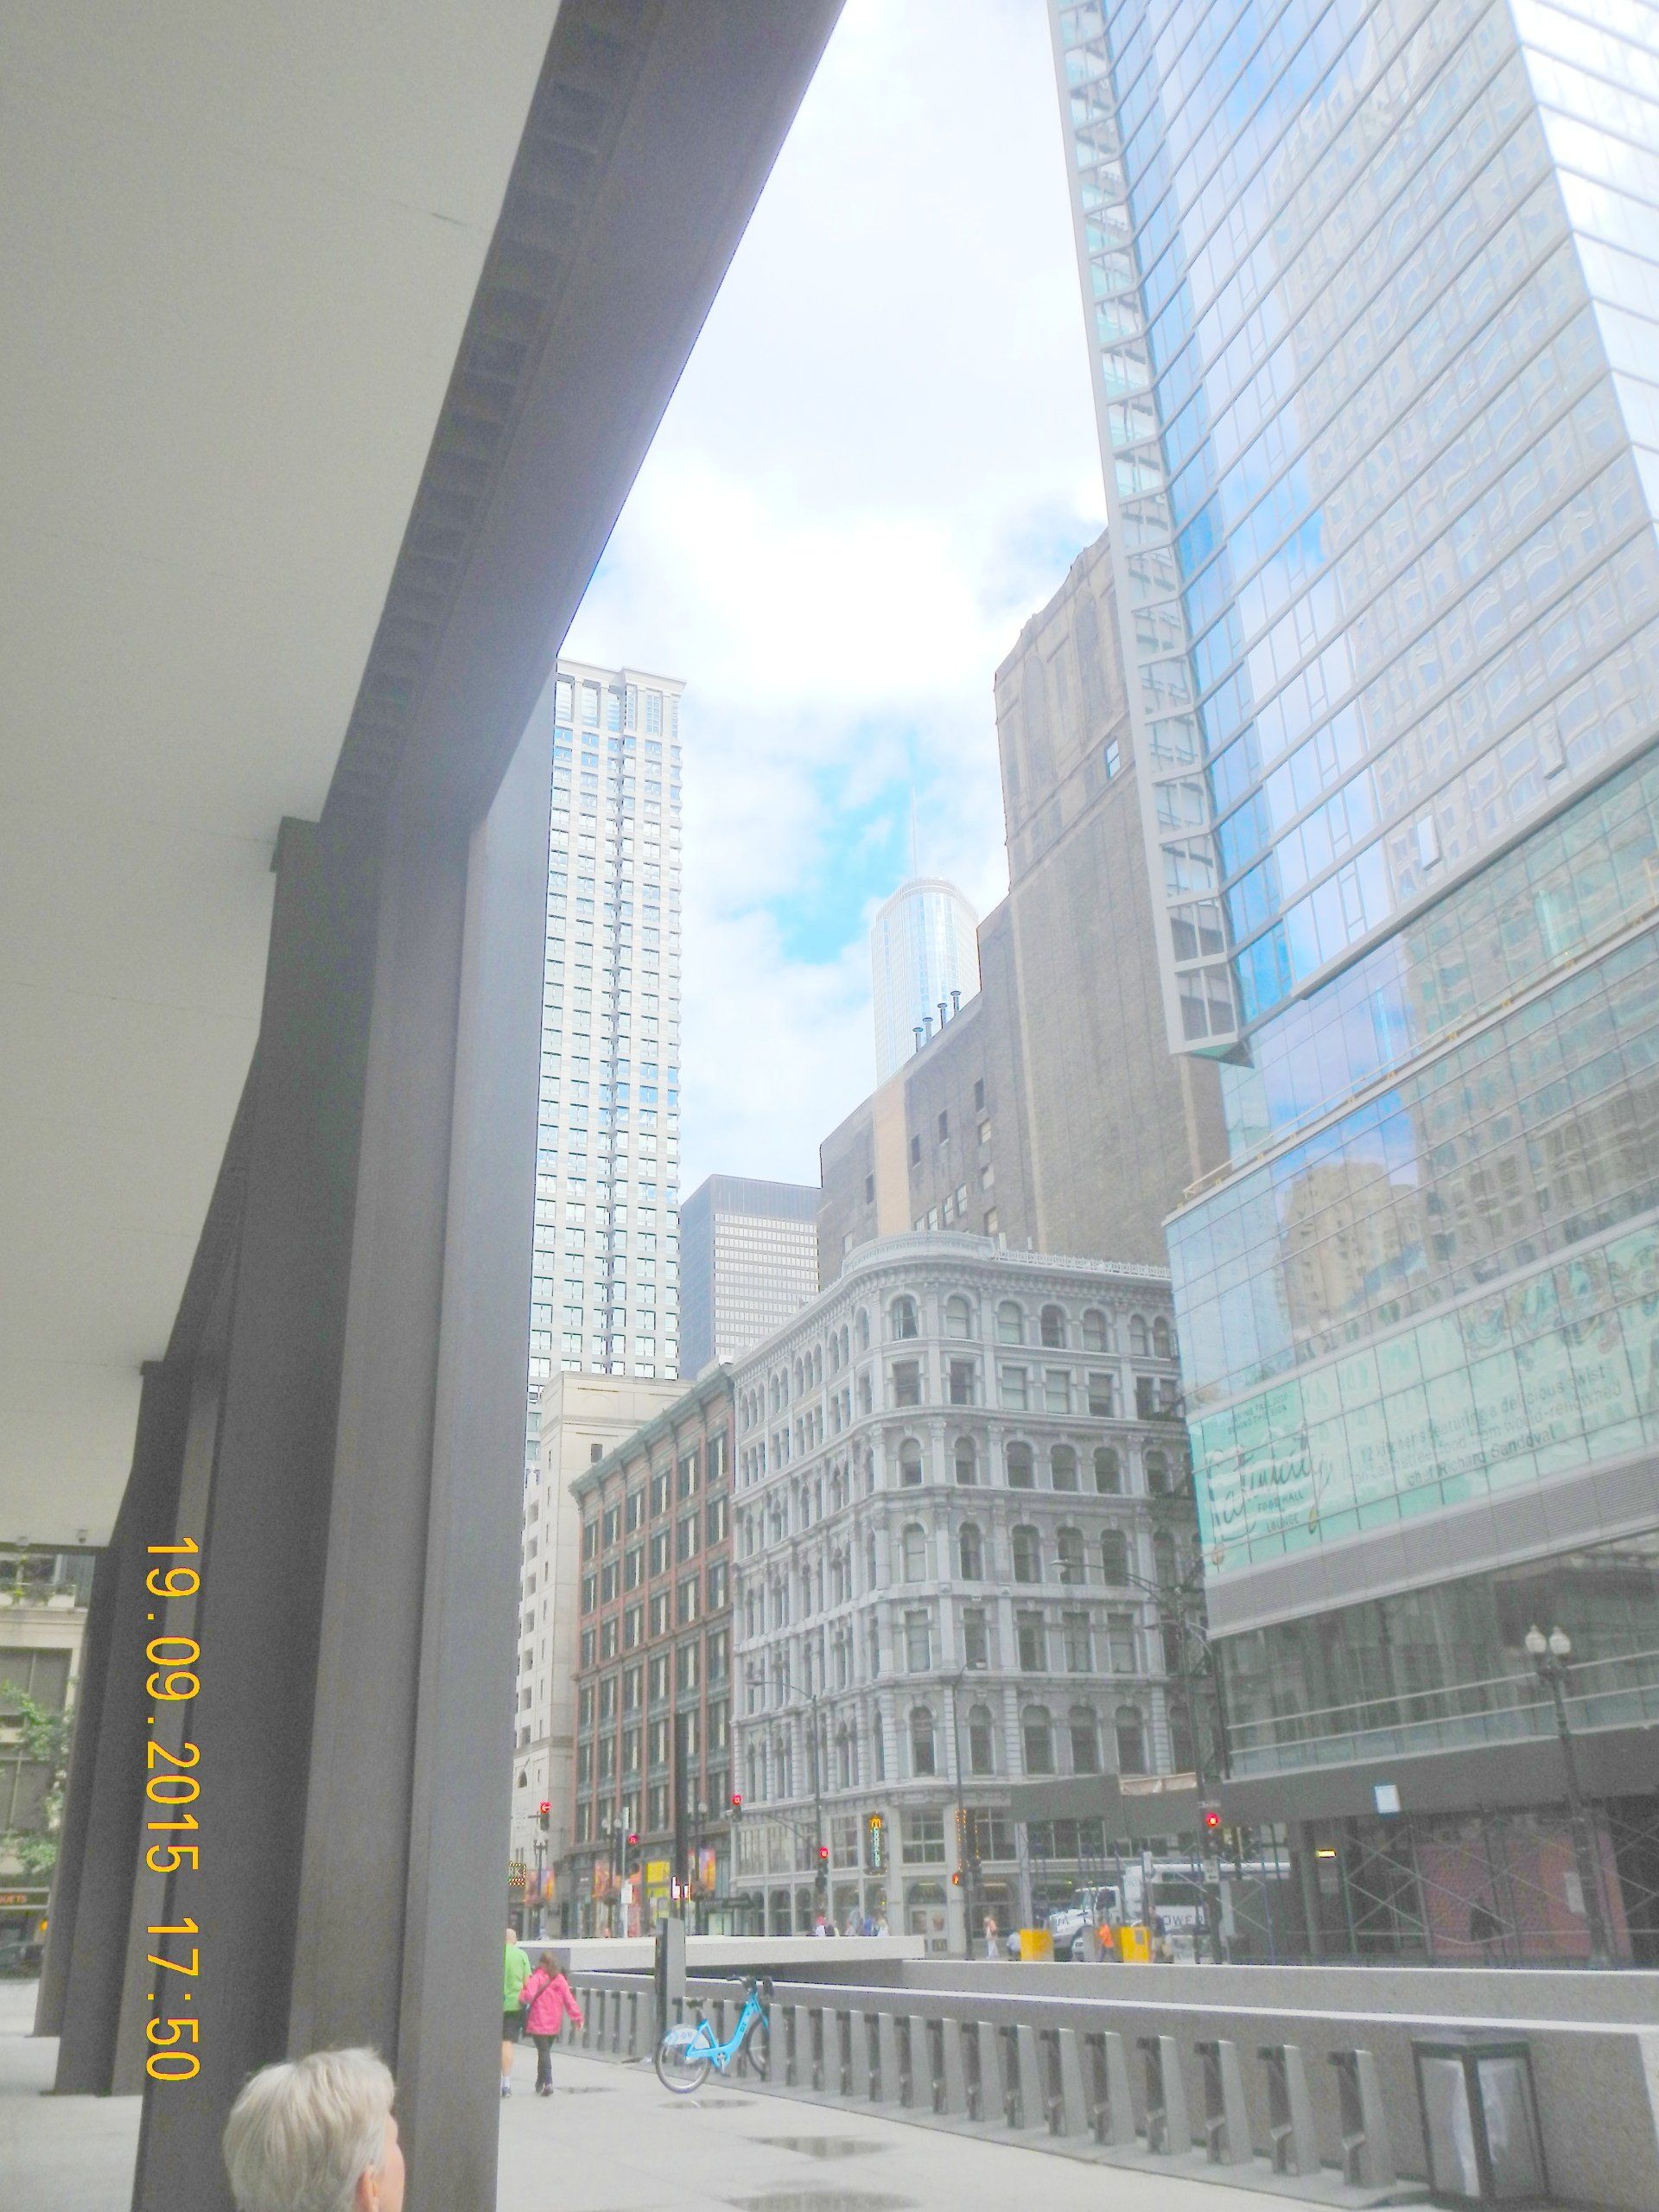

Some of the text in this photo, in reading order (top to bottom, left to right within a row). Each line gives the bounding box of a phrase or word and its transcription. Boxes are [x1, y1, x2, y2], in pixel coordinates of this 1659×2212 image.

[1500, 1381, 1566, 1414] delicious
[1568, 1363, 1608, 1389] twist
[1437, 1451, 1488, 1478] Richard
[1491, 1422, 1556, 1462] Sandoval
[1282, 1489, 1305, 1504] HALL
